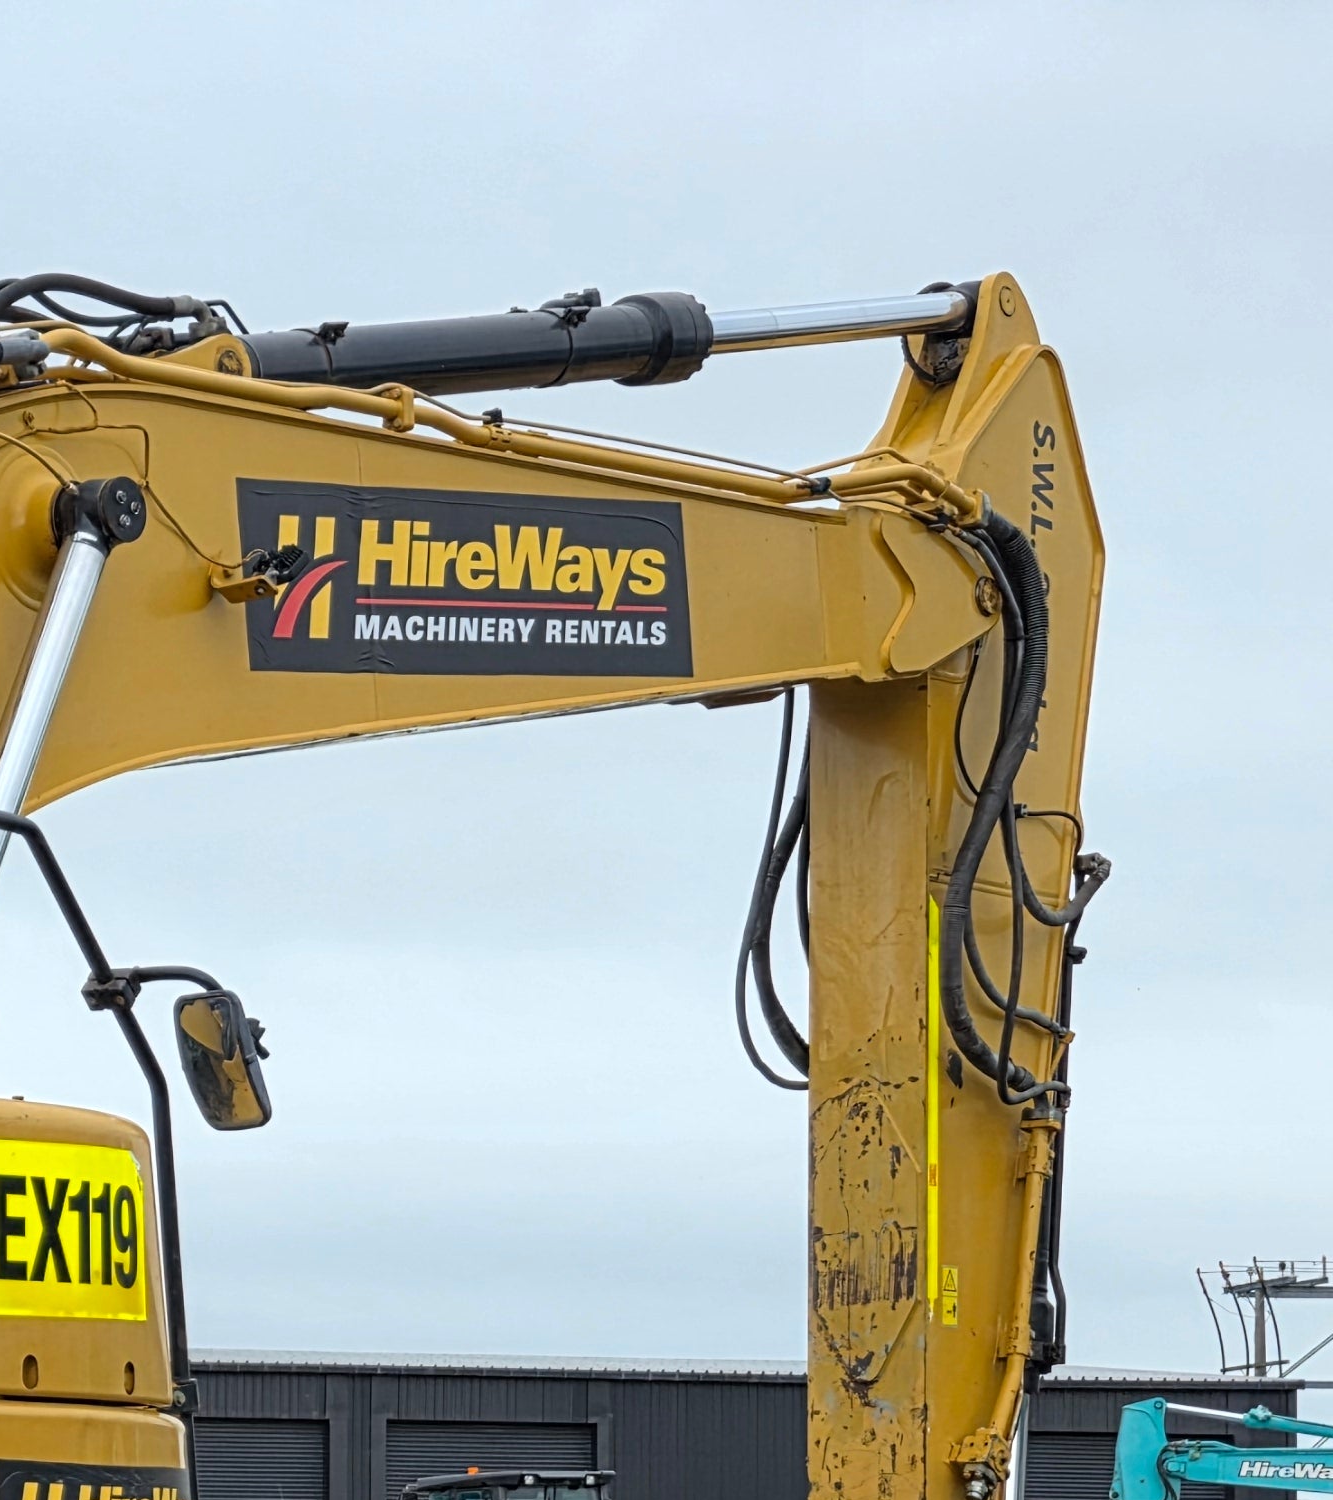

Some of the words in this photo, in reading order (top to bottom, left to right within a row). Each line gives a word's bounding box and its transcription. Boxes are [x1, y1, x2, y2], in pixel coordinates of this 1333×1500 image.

[357, 519, 666, 610] HireWays
[354, 614, 535, 643] MACHINERY
[545, 619, 667, 646] RENTALS
[1239, 1460, 1333, 1479] HireWa
